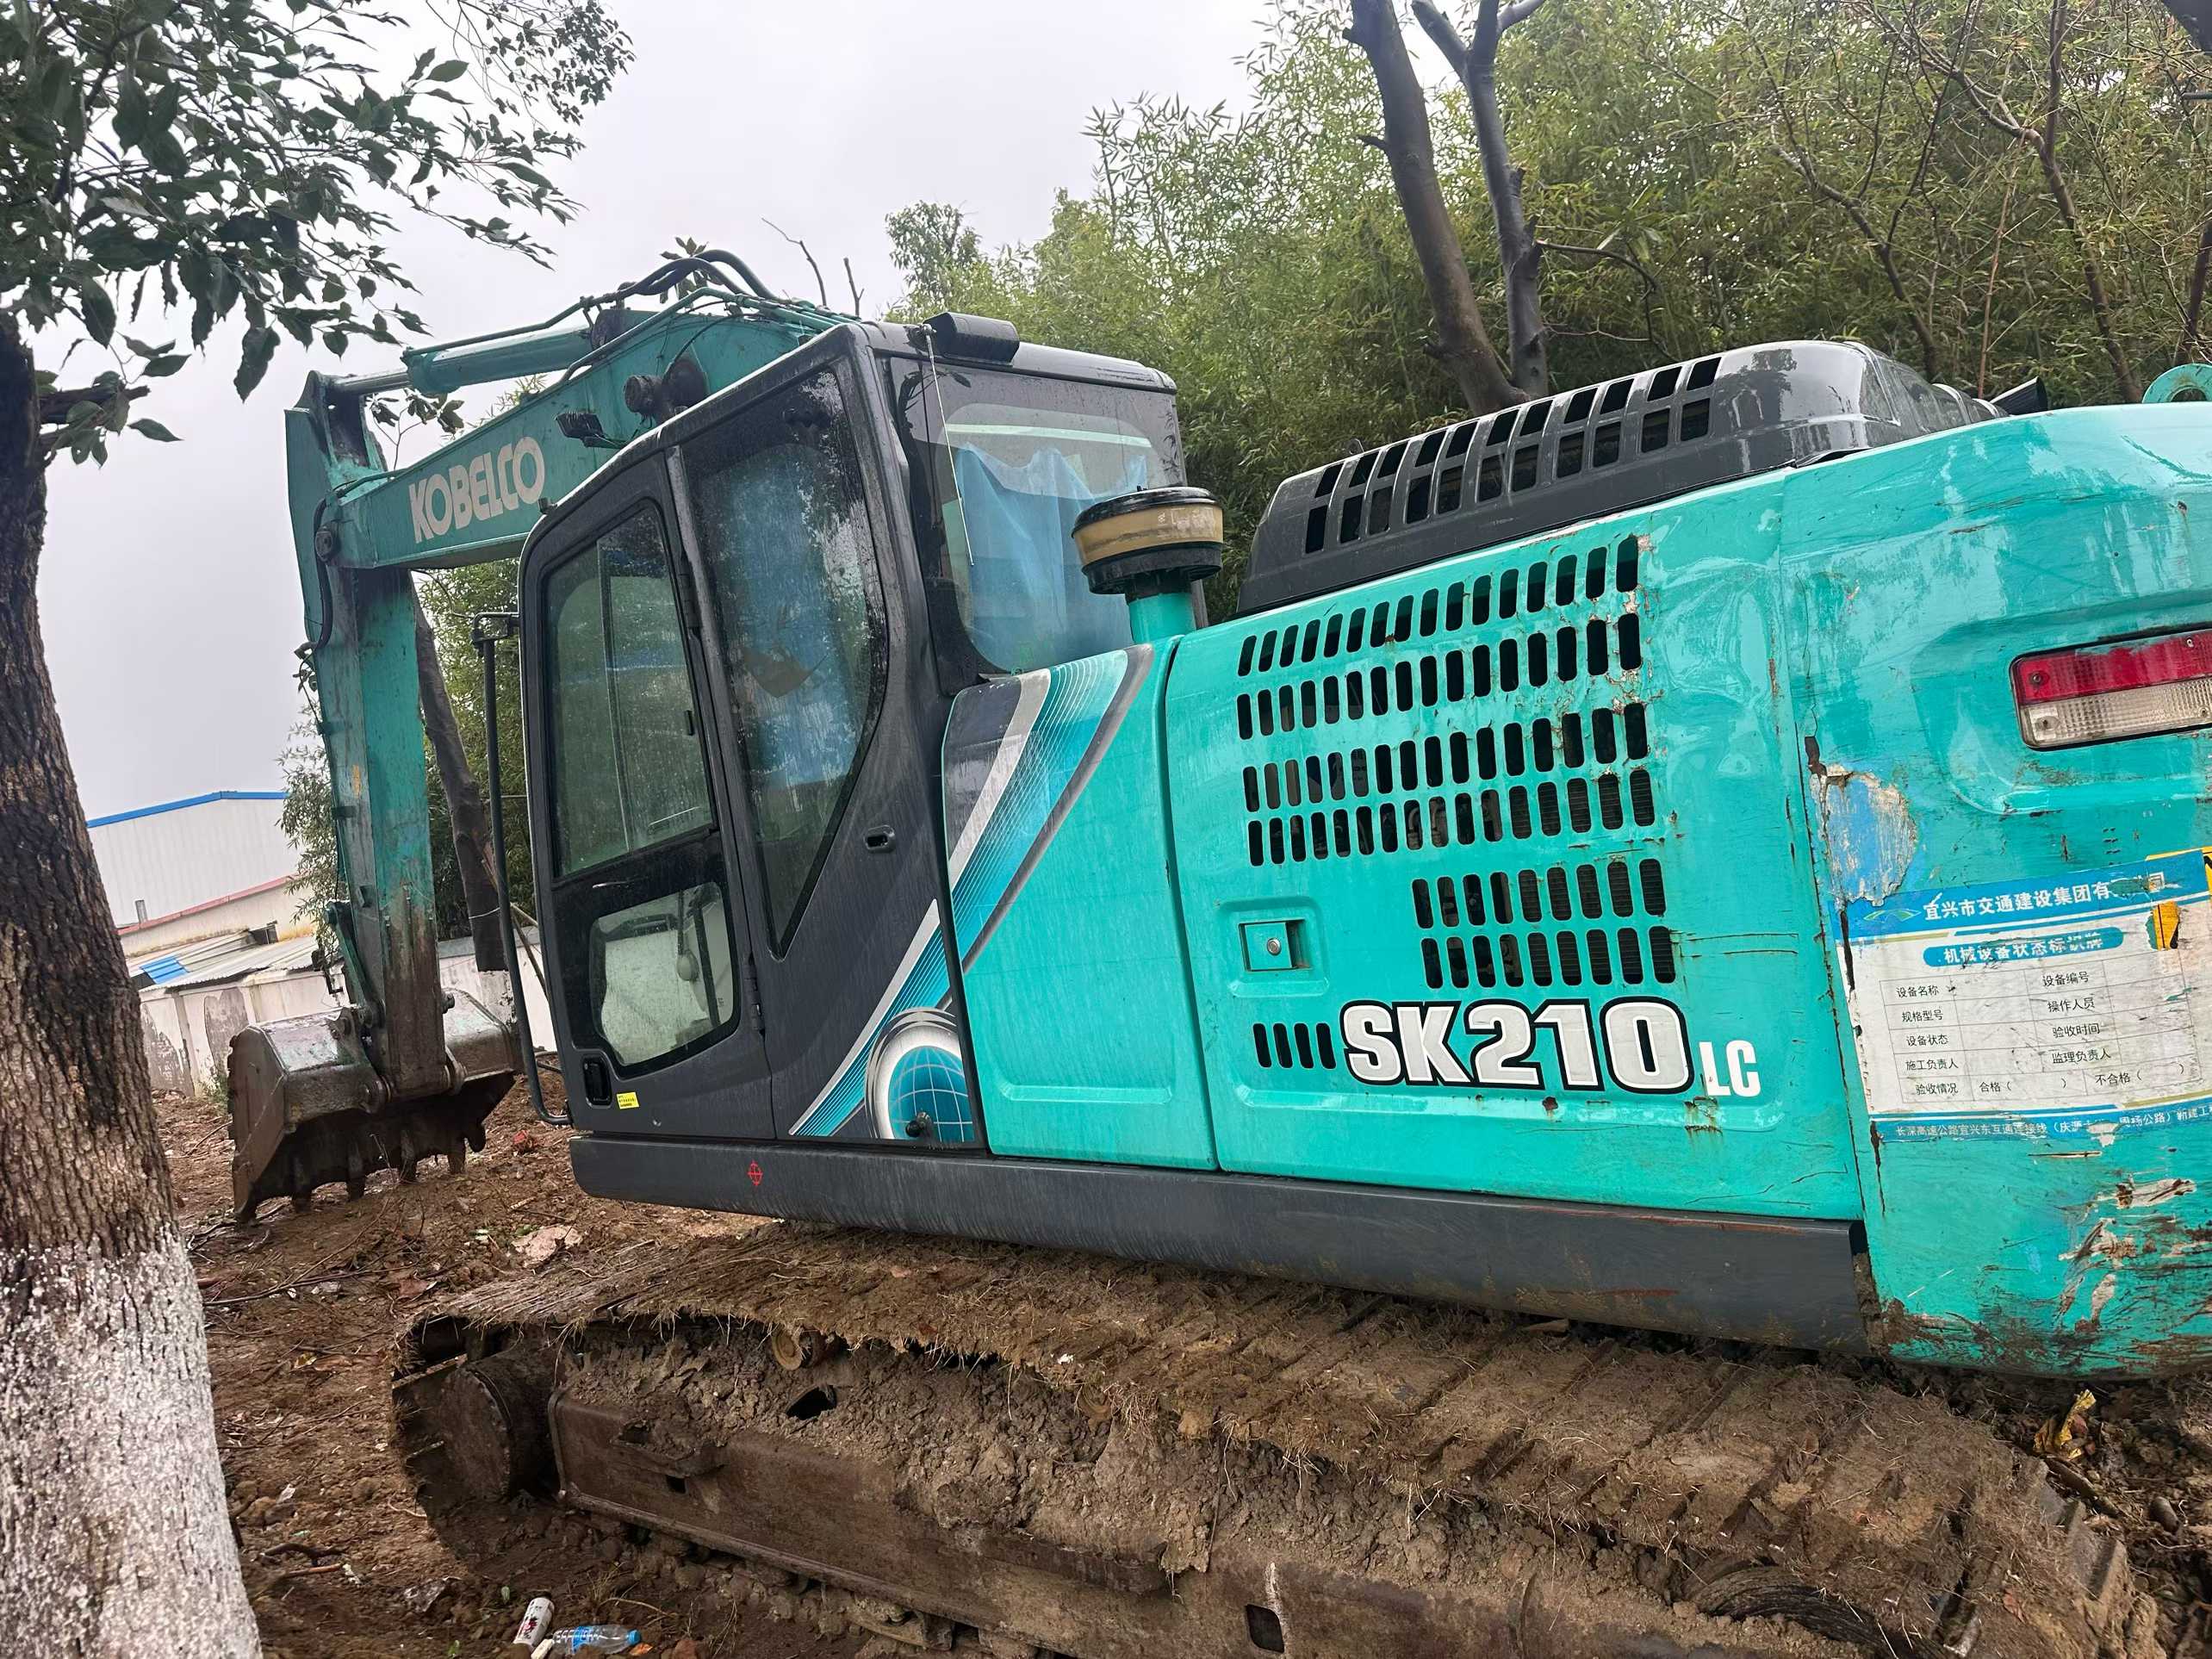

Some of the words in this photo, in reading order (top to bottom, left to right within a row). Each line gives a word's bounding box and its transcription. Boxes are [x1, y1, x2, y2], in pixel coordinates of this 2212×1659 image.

[408, 437, 545, 544] KOBELCO
[2042, 971, 2090, 987] 设备编号
[1897, 985, 1939, 997] 设备名称
[2047, 997, 2096, 1012] 操作人员
[1901, 1009, 1943, 1022] 规格型号
[2053, 1022, 2100, 1039] 验收时间
[1339, 996, 1694, 1094] SK210
[1699, 1040, 1761, 1097] LC
[1906, 1034, 1948, 1047] 设备状态
[2052, 1048, 2111, 1065] 监理负责人
[1905, 1058, 1959, 1071] 施工负责人
[1916, 1083, 1958, 1096] 验收情况
